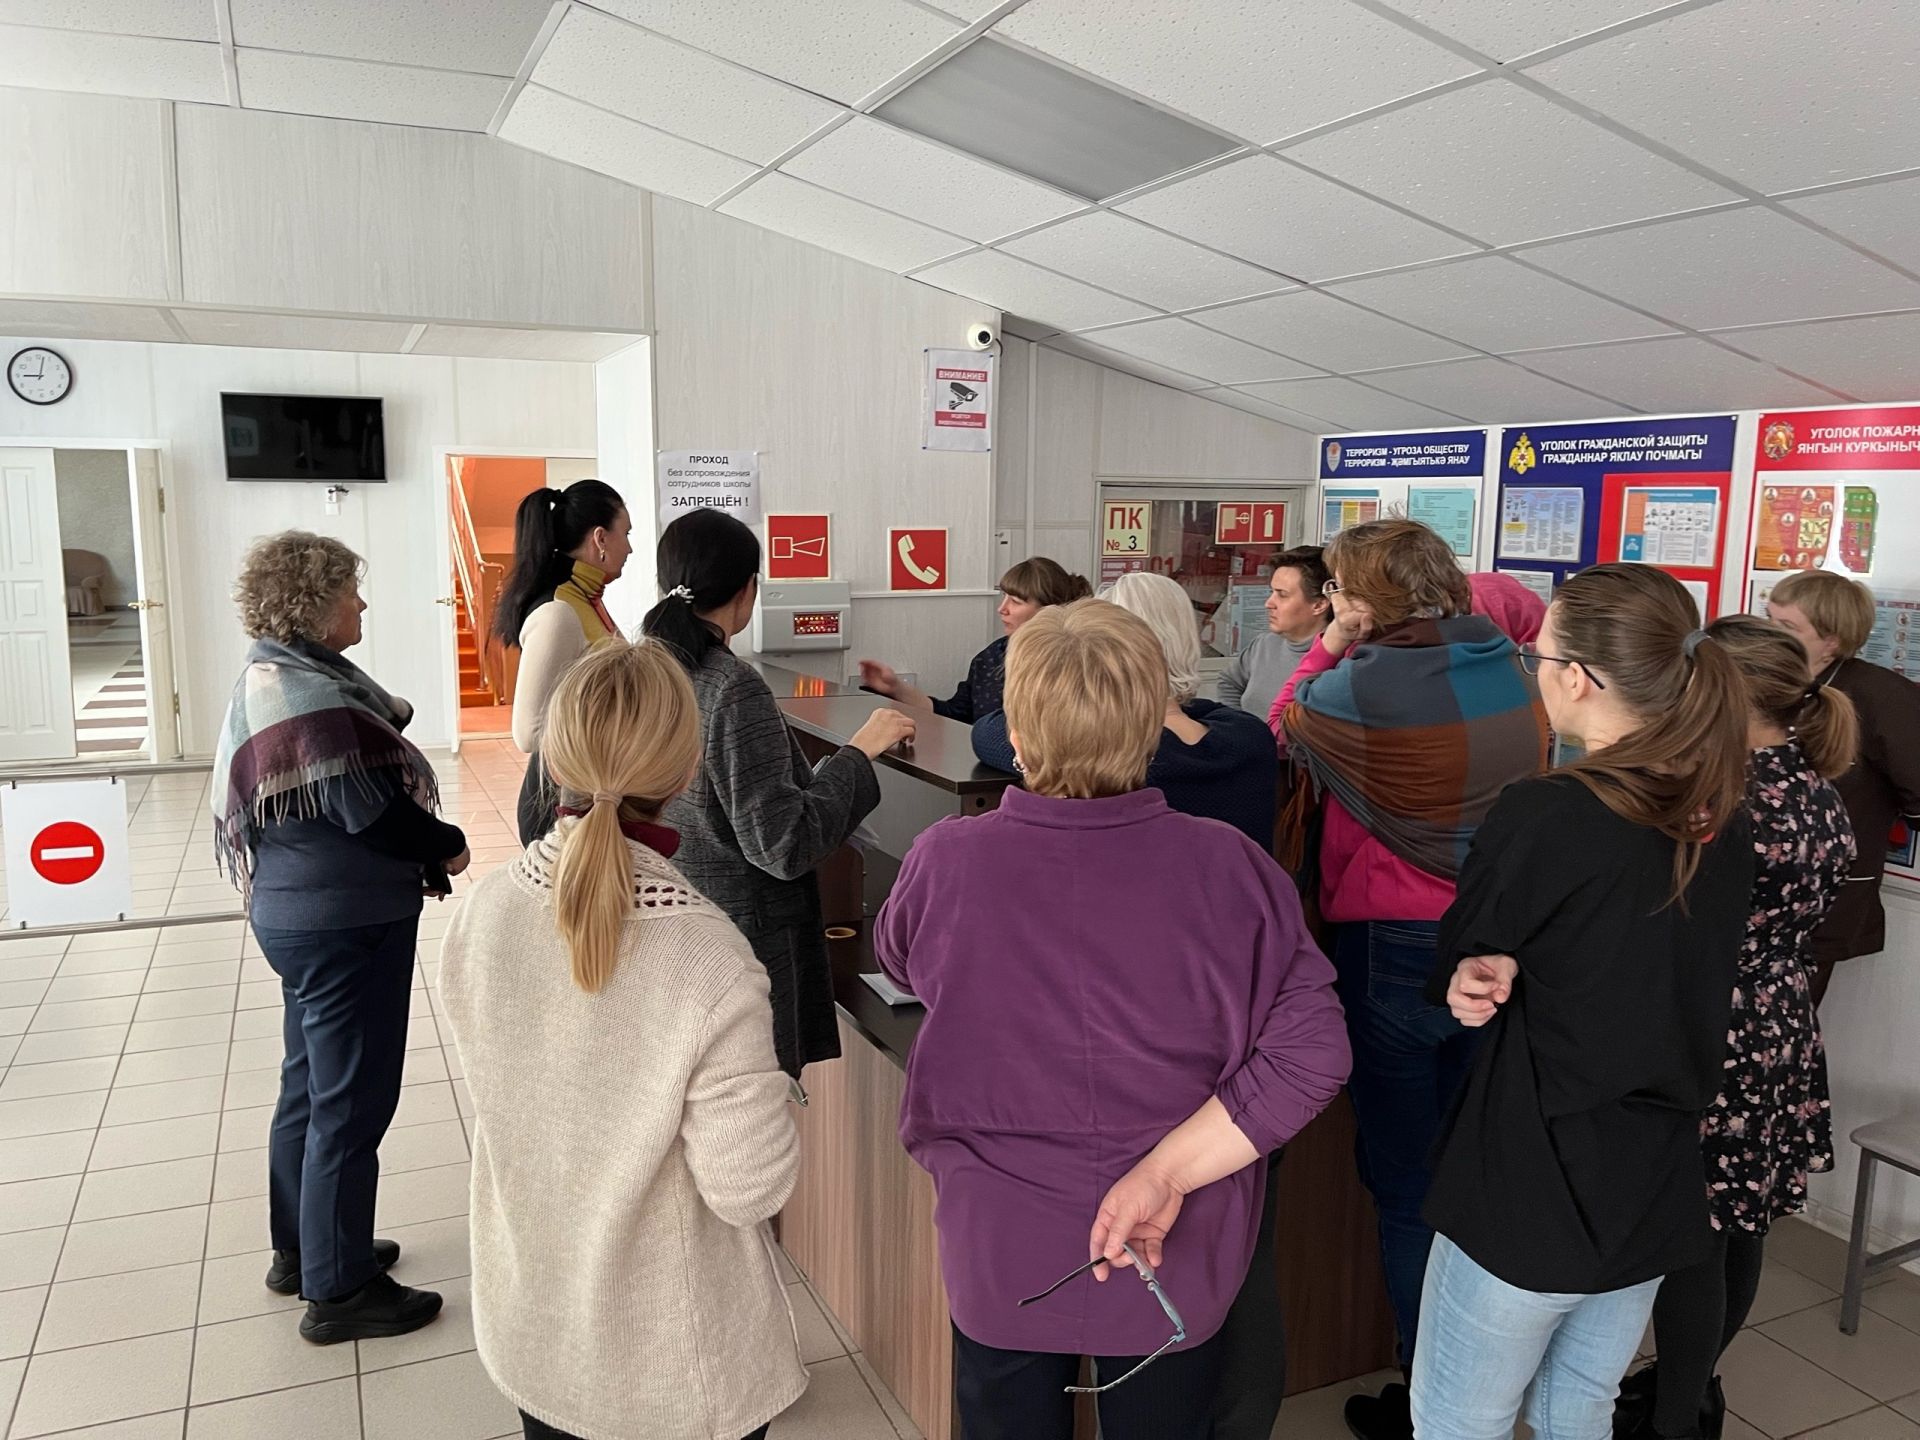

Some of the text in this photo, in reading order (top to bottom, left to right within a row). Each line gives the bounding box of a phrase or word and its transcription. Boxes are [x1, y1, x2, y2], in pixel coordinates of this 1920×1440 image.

[938, 370, 985, 380] ВНИМАНИЕ!
[1810, 425, 1920, 439] УГОЛОК ПОЖАРН
[1540, 434, 1708, 451] УГОЛОК ГРАЖДАНСКОЙ ЗАЩИТЫ
[1797, 440, 1920, 454] ЯНГЫН КУРКЫНЫЧ
[1345, 447, 1388, 457] ТЕРРОРИЗМ
[1392, 446, 1423, 456] УГРОЗА
[1423, 444, 1470, 455] ОБЩЕСТВУ
[1543, 449, 1702, 464] ГРАЖДАННАР ЯКЛАУ ПОЧМАГЫ
[689, 455, 729, 464] ПРОХОД
[1344, 458, 1387, 468] ТЕРРОРИЗМ
[1446, 455, 1471, 465] ЯНАУ
[667, 468, 751, 478] без сопровождения
[667, 480, 721, 489] сотрудников
[671, 494, 742, 508] ЗАПРЕЩЁН
[1109, 507, 1143, 529] ПК
[1106, 535, 1137, 551] № 3
